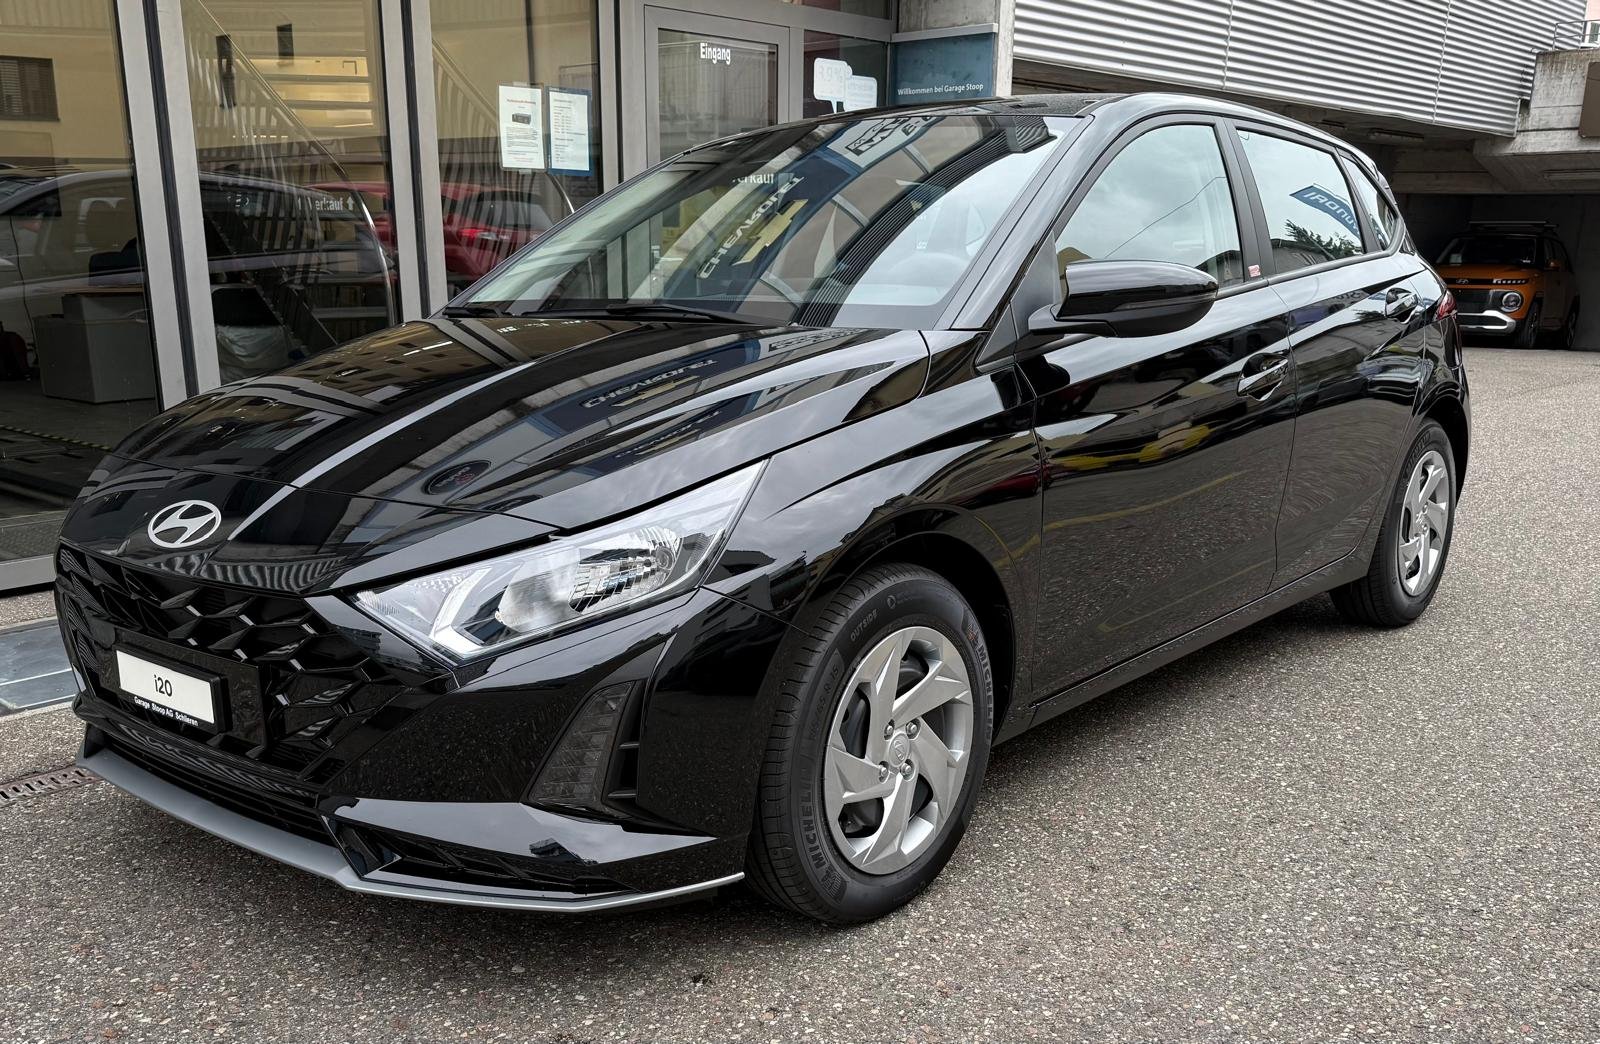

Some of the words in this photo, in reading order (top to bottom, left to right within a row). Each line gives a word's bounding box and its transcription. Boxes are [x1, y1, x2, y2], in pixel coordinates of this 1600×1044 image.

[700, 42, 731, 65] Eingang
[897, 87, 933, 96] Willkommen
[934, 85, 944, 93] bei
[944, 83, 965, 94] Garage
[965, 82, 984, 92] Stoop
[850, 609, 878, 642] OUTSIDE
[154, 674, 172, 697] i20
[134, 696, 151, 709] Garage
[151, 702, 166, 715] Stoop
[165, 708, 174, 717] AG
[175, 711, 199, 727] Schlieren
